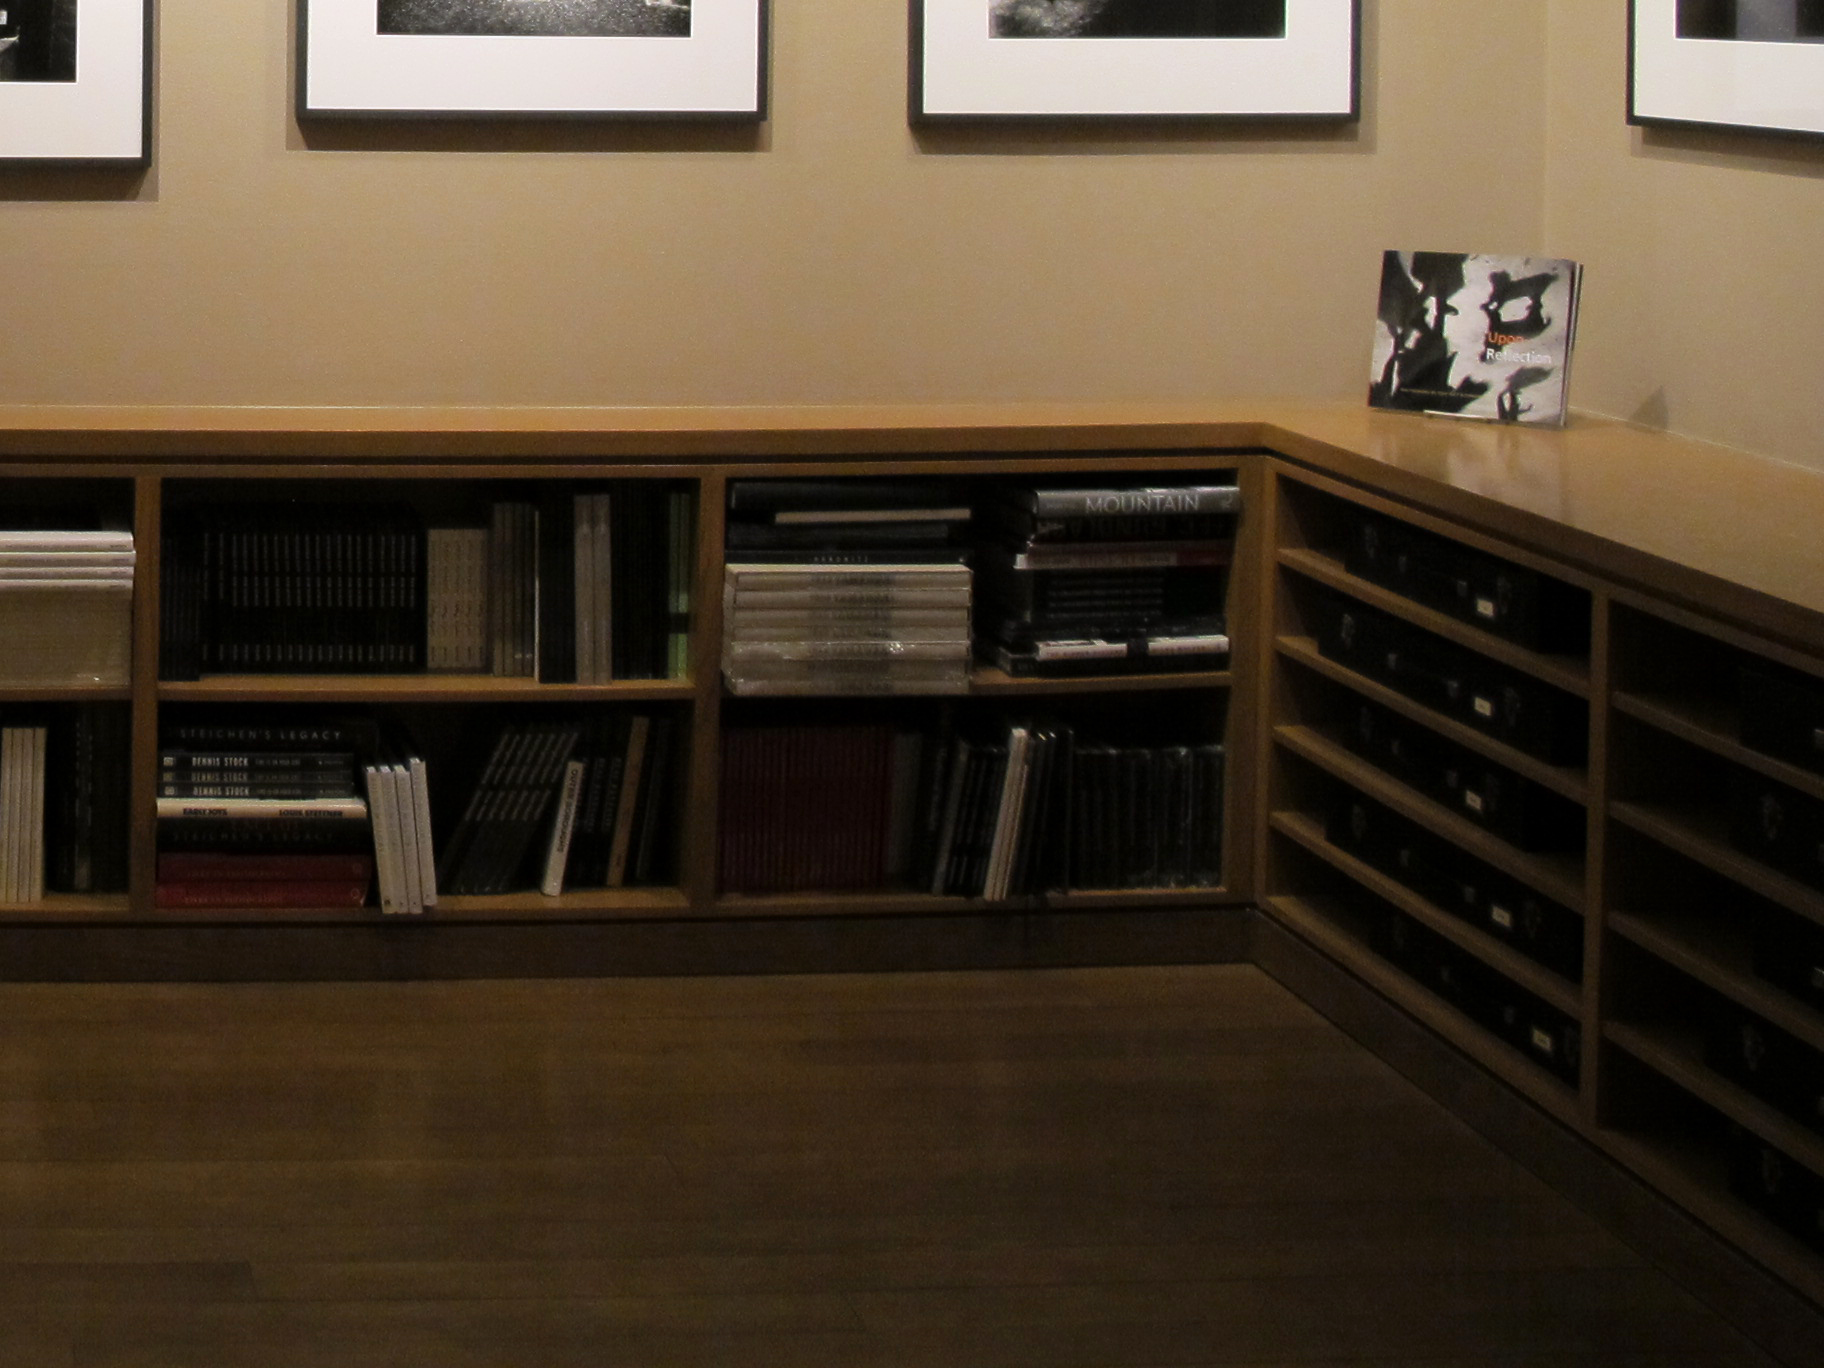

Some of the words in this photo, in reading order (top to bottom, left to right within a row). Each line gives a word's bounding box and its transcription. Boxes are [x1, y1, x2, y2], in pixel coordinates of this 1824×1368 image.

[1488, 332, 1525, 346] Upon
[1486, 348, 1552, 364] Reflection
[1085, 495, 1200, 513] MOUNTAIN
[179, 728, 272, 740] STEICHEN'S
[279, 730, 342, 741] LEGACY
[191, 756, 221, 767] DENNIS
[223, 756, 249, 767] STOCK
[191, 772, 220, 782] DENNIS
[223, 772, 248, 782] STOCK
[565, 768, 580, 800] OUTER
[192, 786, 222, 796] DENNIS
[225, 787, 250, 796] STOCK
